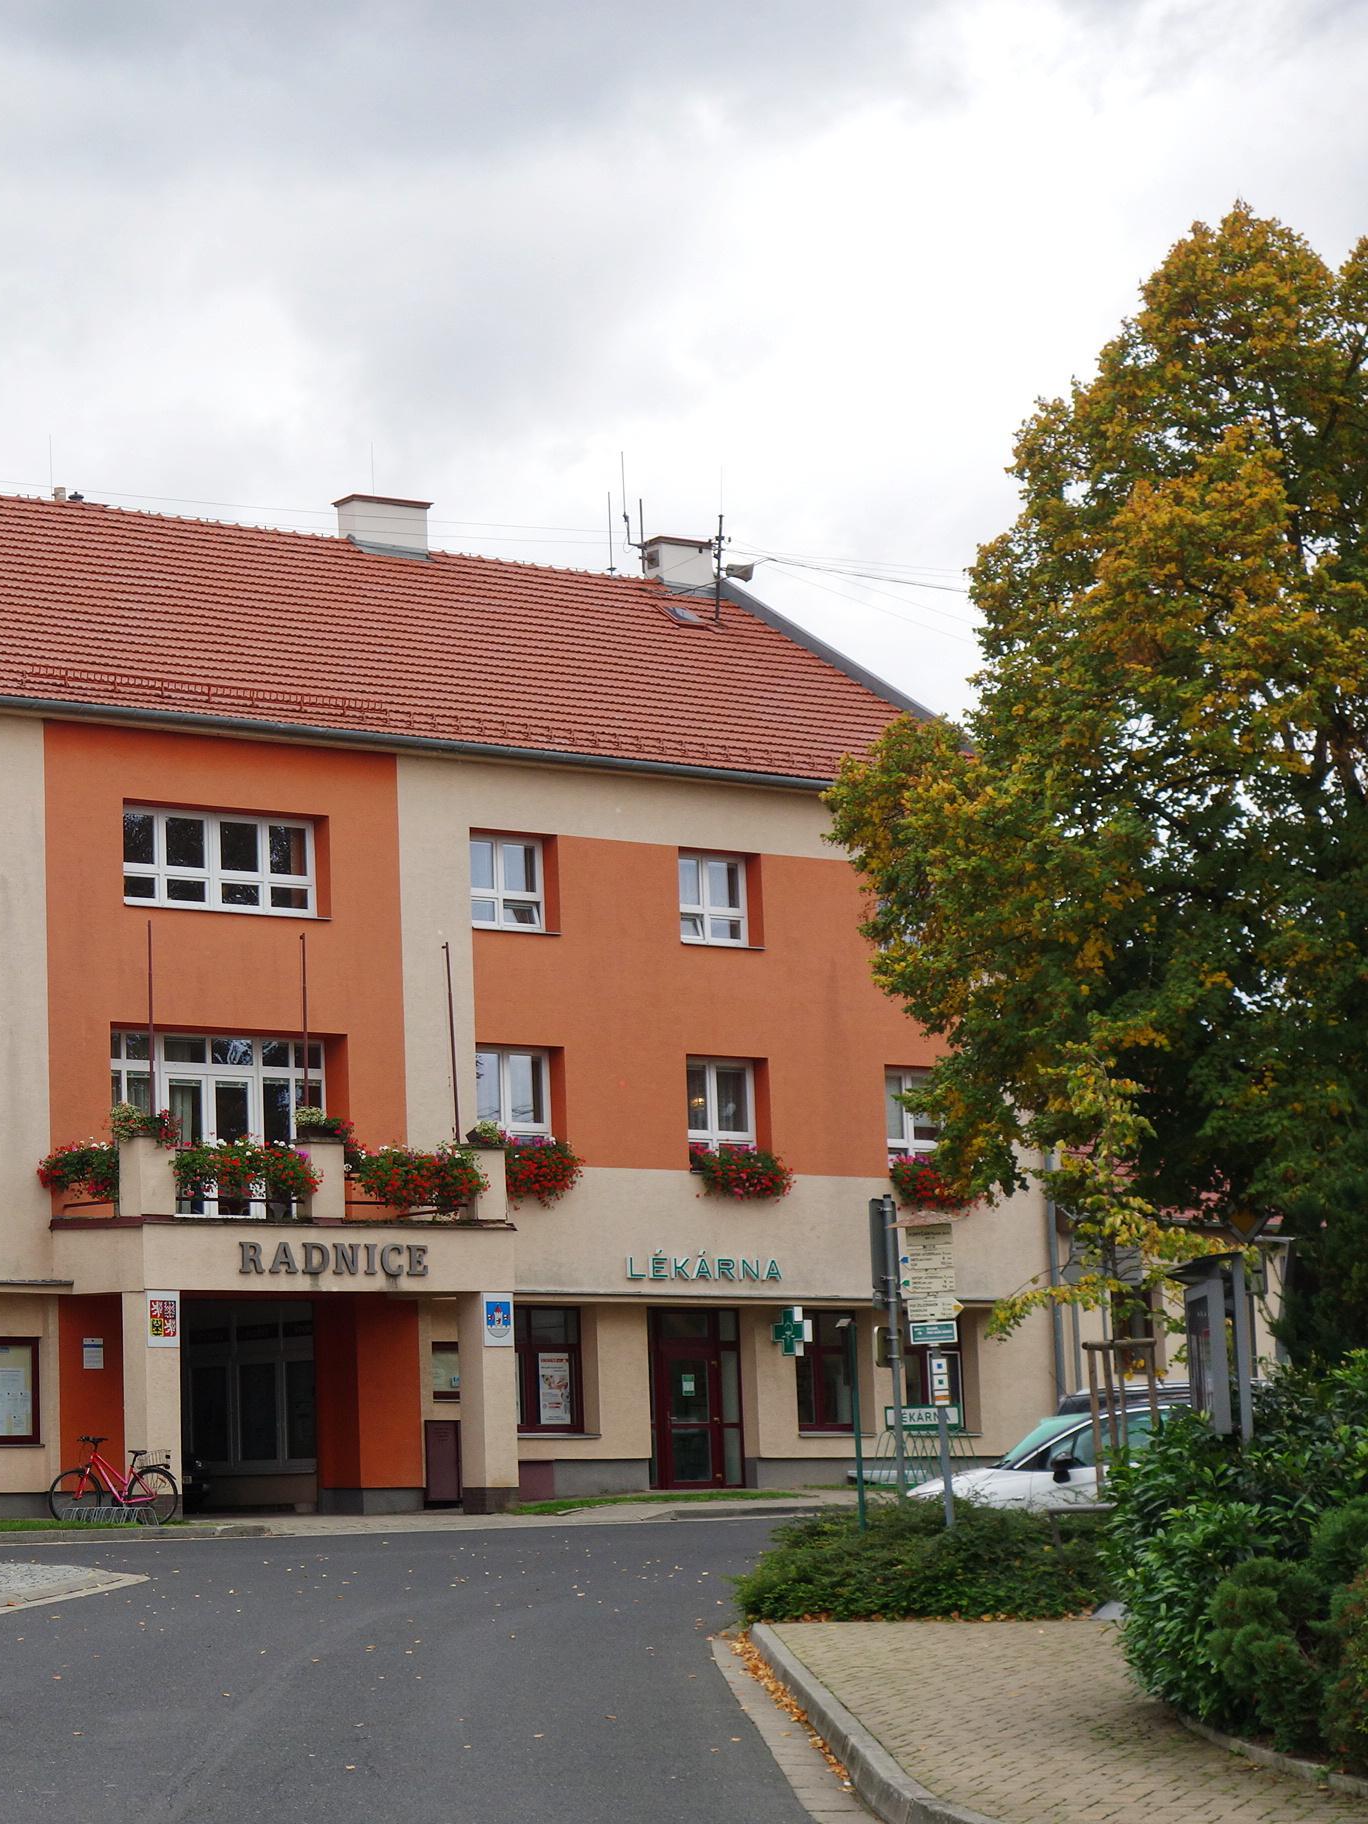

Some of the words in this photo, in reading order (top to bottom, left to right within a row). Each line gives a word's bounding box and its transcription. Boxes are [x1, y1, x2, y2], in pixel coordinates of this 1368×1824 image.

[239, 1242, 429, 1276] RADNICE
[626, 1249, 782, 1281] LÉKÁRNA
[897, 1410, 951, 1423] ÉKÁRN
